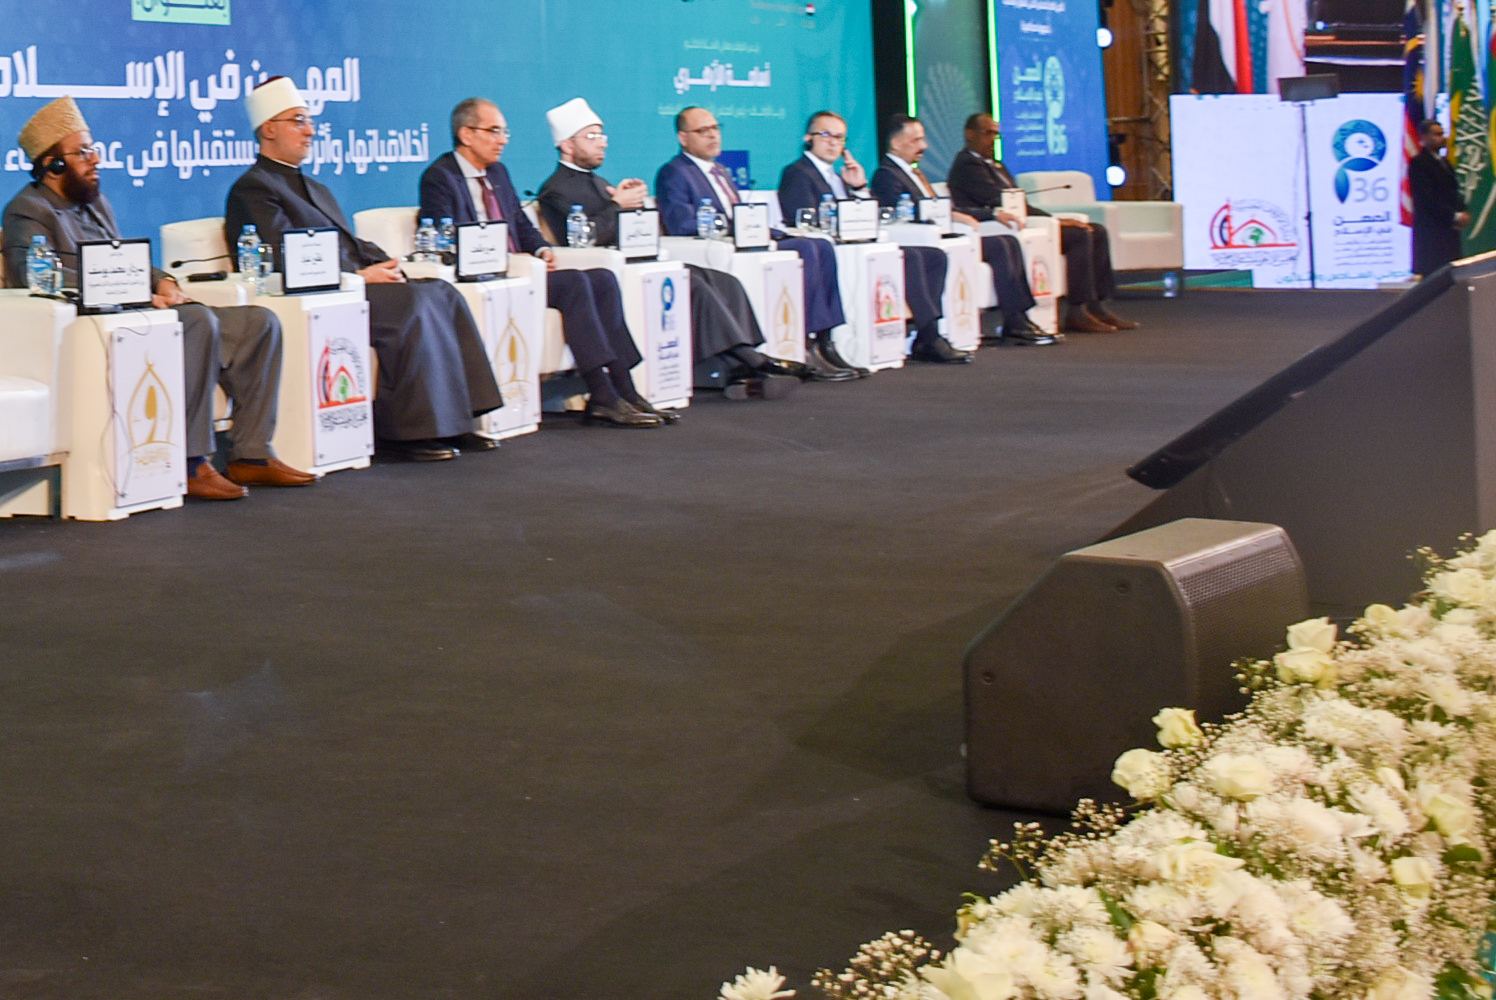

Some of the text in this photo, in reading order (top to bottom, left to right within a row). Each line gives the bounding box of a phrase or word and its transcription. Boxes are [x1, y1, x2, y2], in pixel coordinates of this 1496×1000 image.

[190, 49, 241, 124] في
[127, 130, 168, 187] في
[303, 121, 343, 175] وأثر
[1354, 177, 1390, 203] 36
